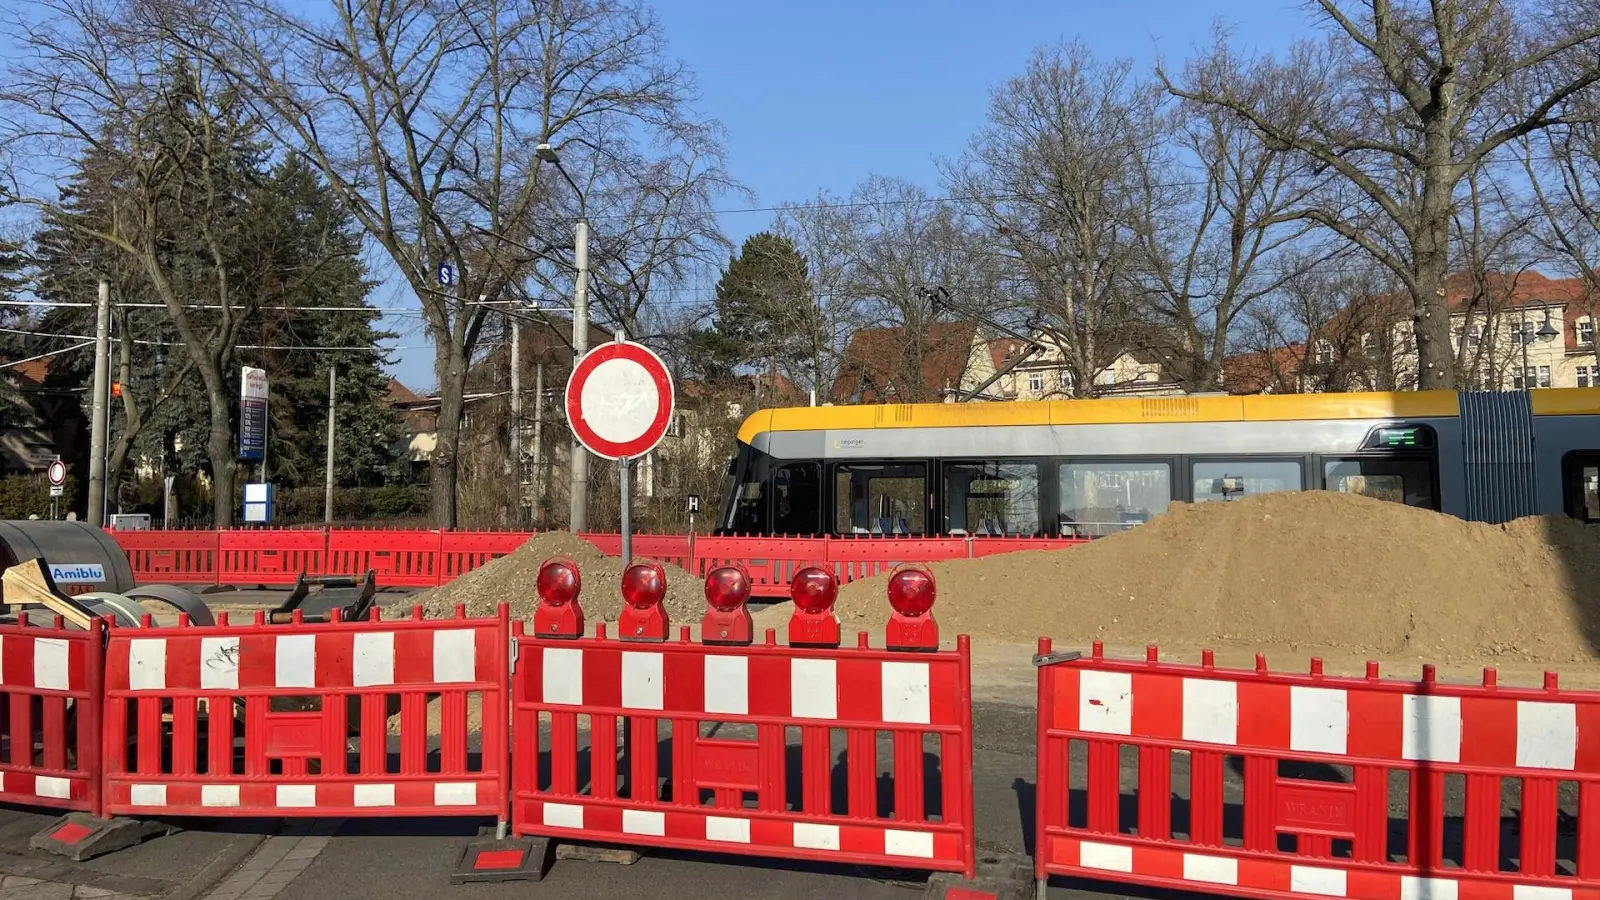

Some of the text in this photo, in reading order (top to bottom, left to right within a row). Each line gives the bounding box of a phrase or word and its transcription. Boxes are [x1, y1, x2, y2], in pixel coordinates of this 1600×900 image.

[441, 267, 450, 283] S
[689, 496, 698, 510] H
[53, 568, 102, 579] Amiblu
